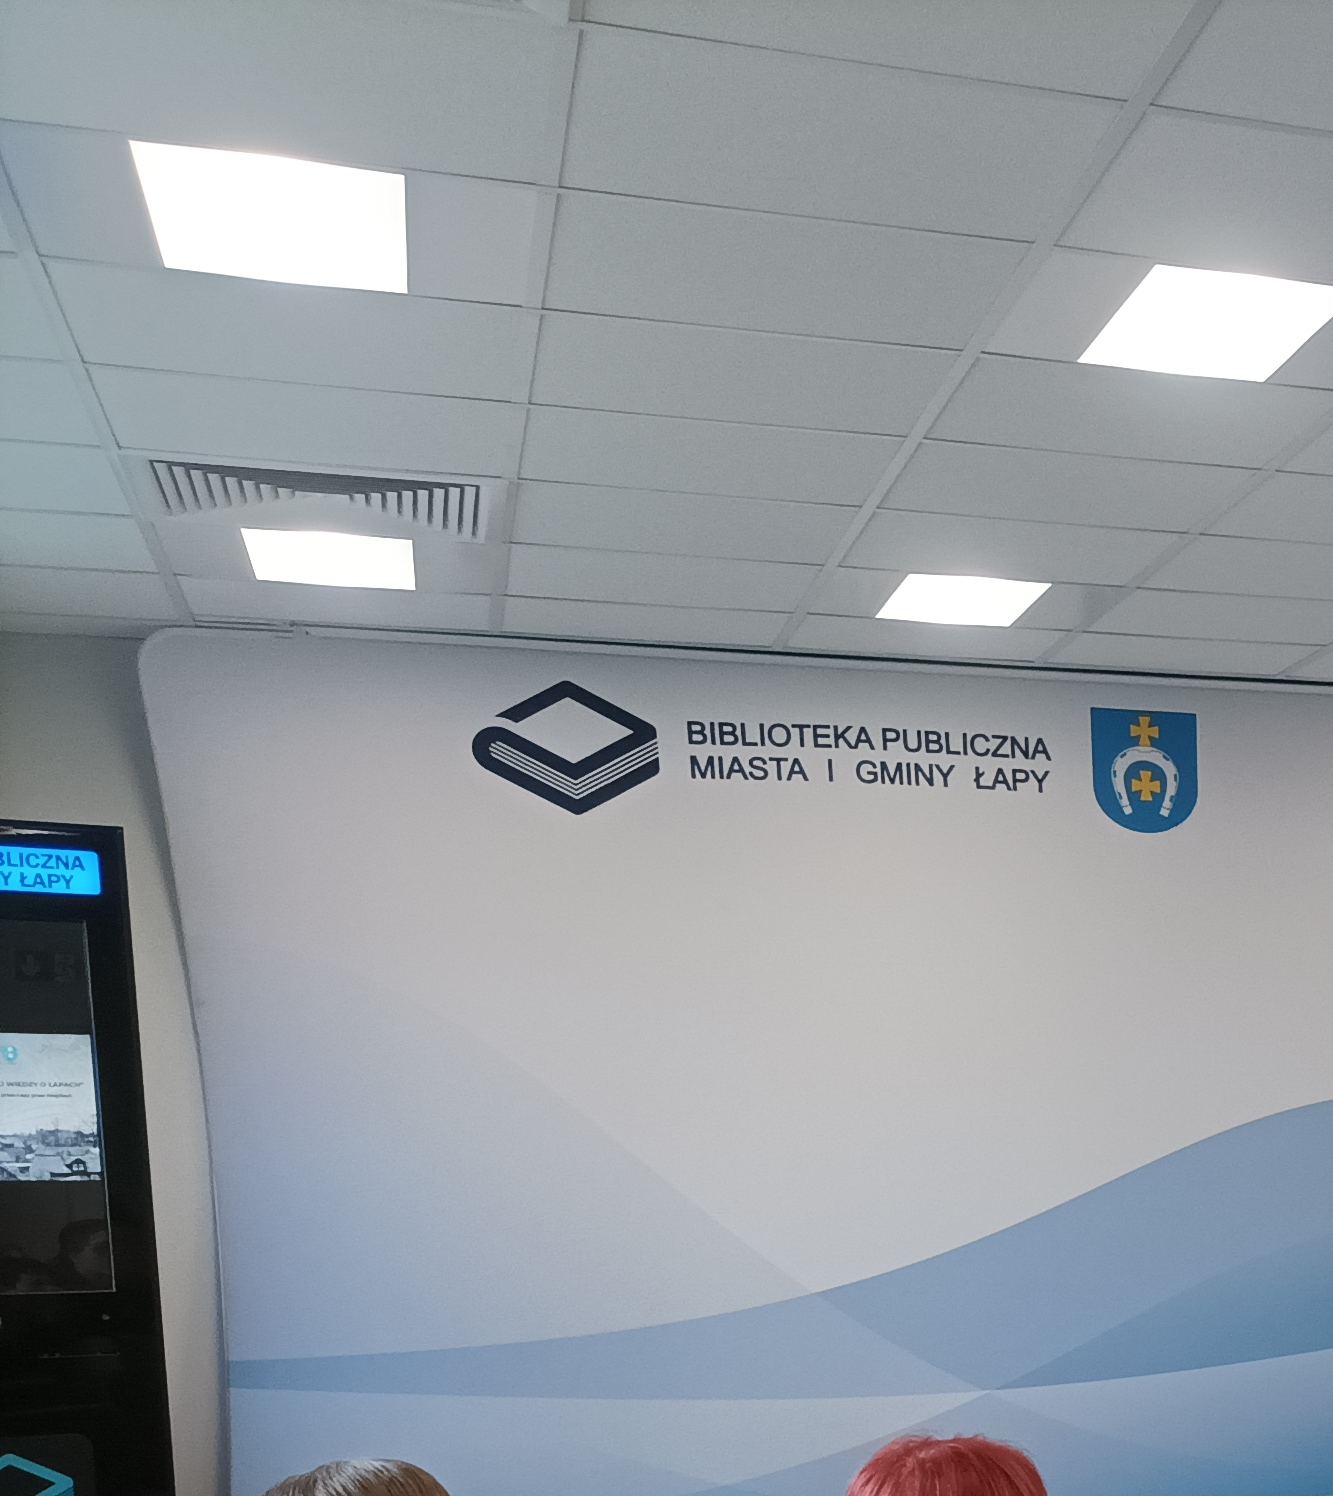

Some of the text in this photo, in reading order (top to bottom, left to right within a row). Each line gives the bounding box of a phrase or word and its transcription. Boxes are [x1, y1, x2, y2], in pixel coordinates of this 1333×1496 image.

[687, 721, 1052, 762] BIBLIOTEKA PUBLICZNA
[689, 755, 1051, 794] MIASTA I GMINY ŁAPY
[19, 871, 74, 890] ŁAPY
